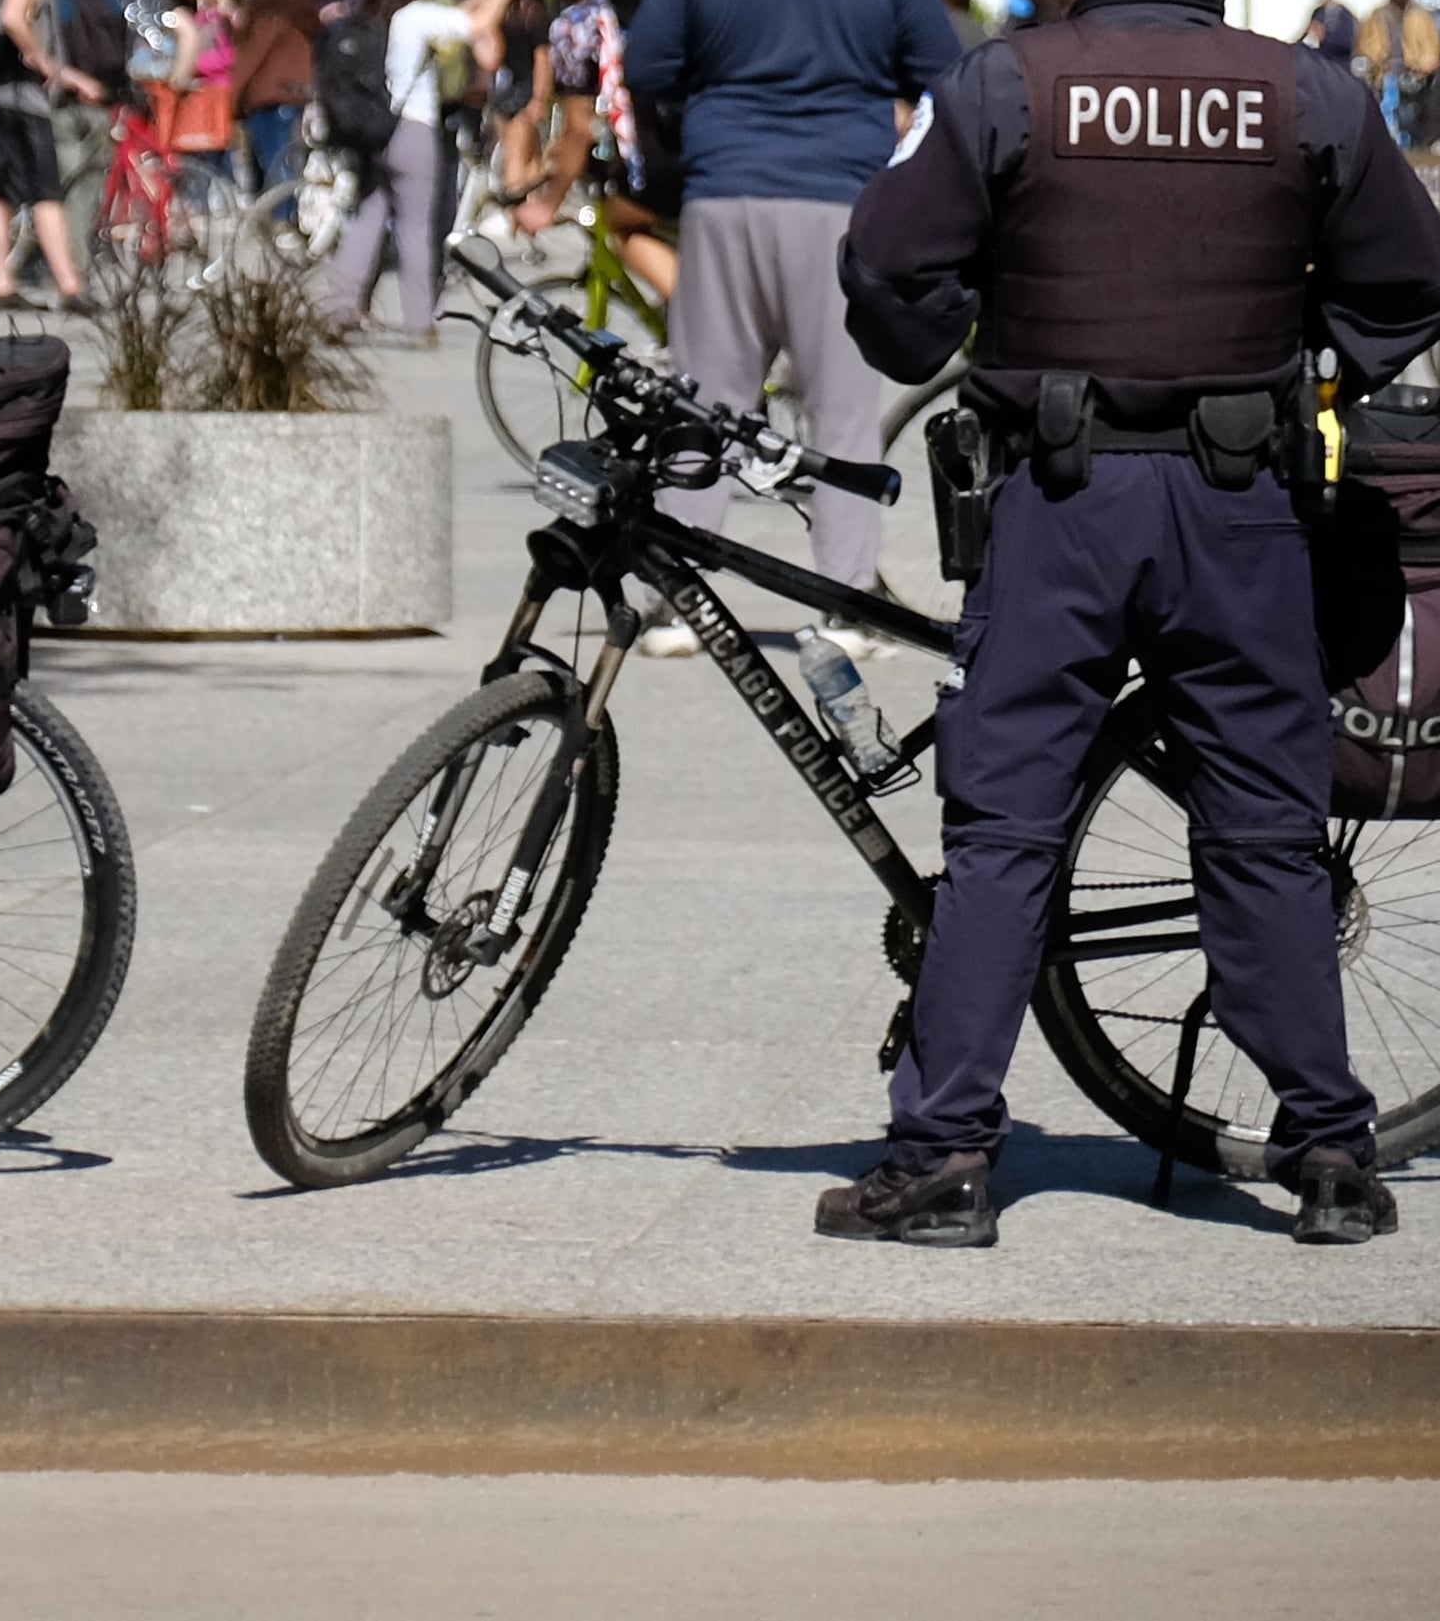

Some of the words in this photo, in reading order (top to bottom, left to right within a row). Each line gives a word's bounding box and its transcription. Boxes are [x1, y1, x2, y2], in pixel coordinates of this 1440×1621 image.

[1068, 85, 1265, 150] POLICE
[673, 583, 784, 716] CHICAGO
[774, 716, 870, 830] POLICE
